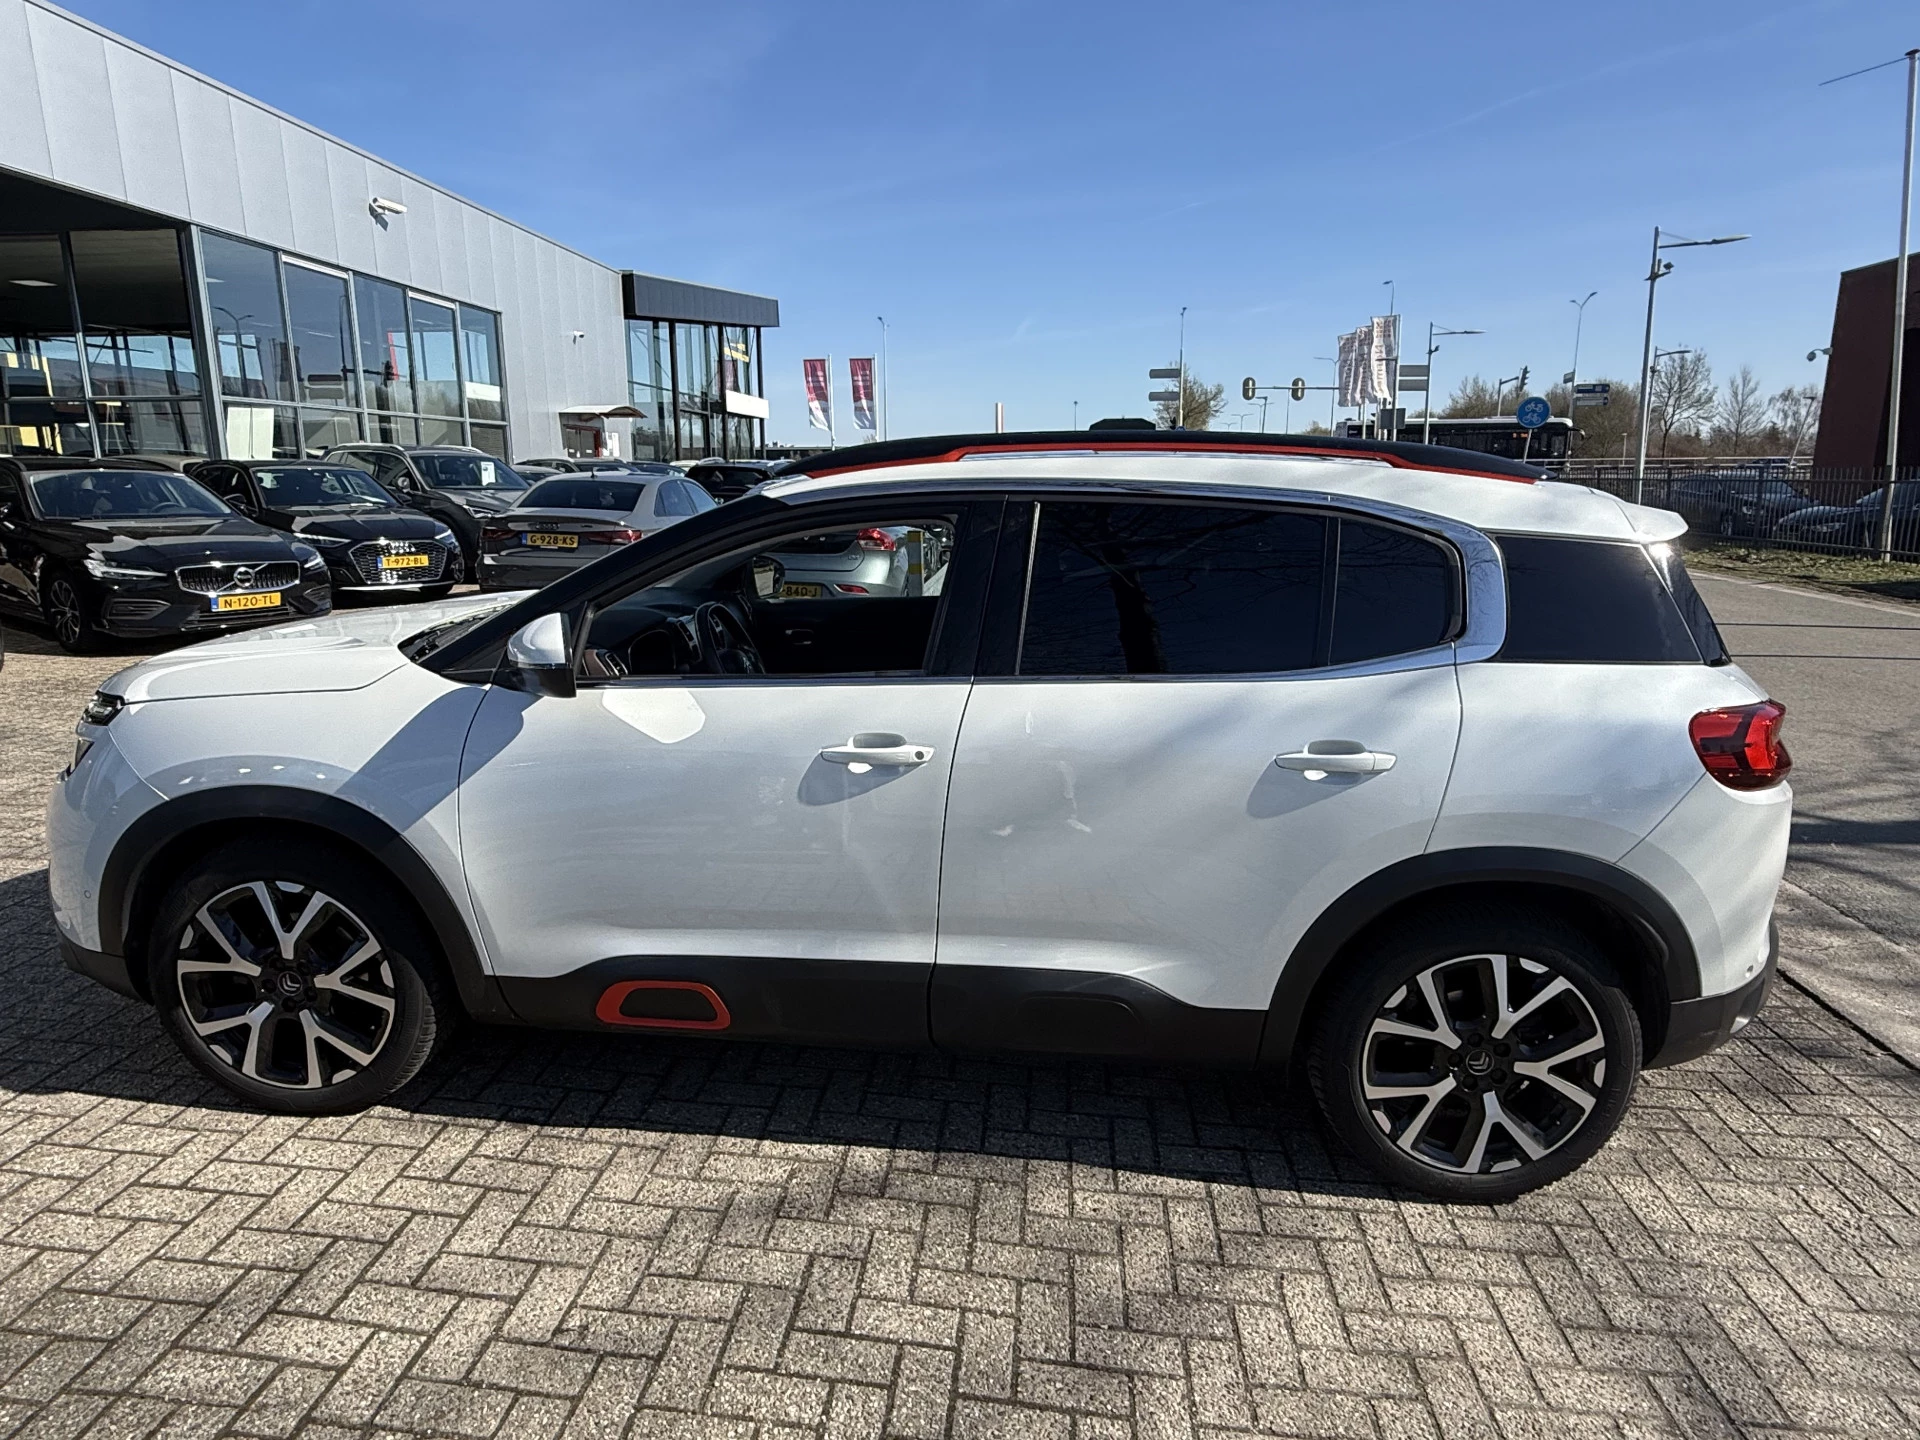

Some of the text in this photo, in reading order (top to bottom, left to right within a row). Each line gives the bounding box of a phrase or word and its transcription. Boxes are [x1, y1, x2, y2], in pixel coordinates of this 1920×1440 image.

[530, 535, 575, 545] G-928-KS
[385, 557, 424, 566] T-972-BL
[224, 595, 275, 608] N-120-TL
